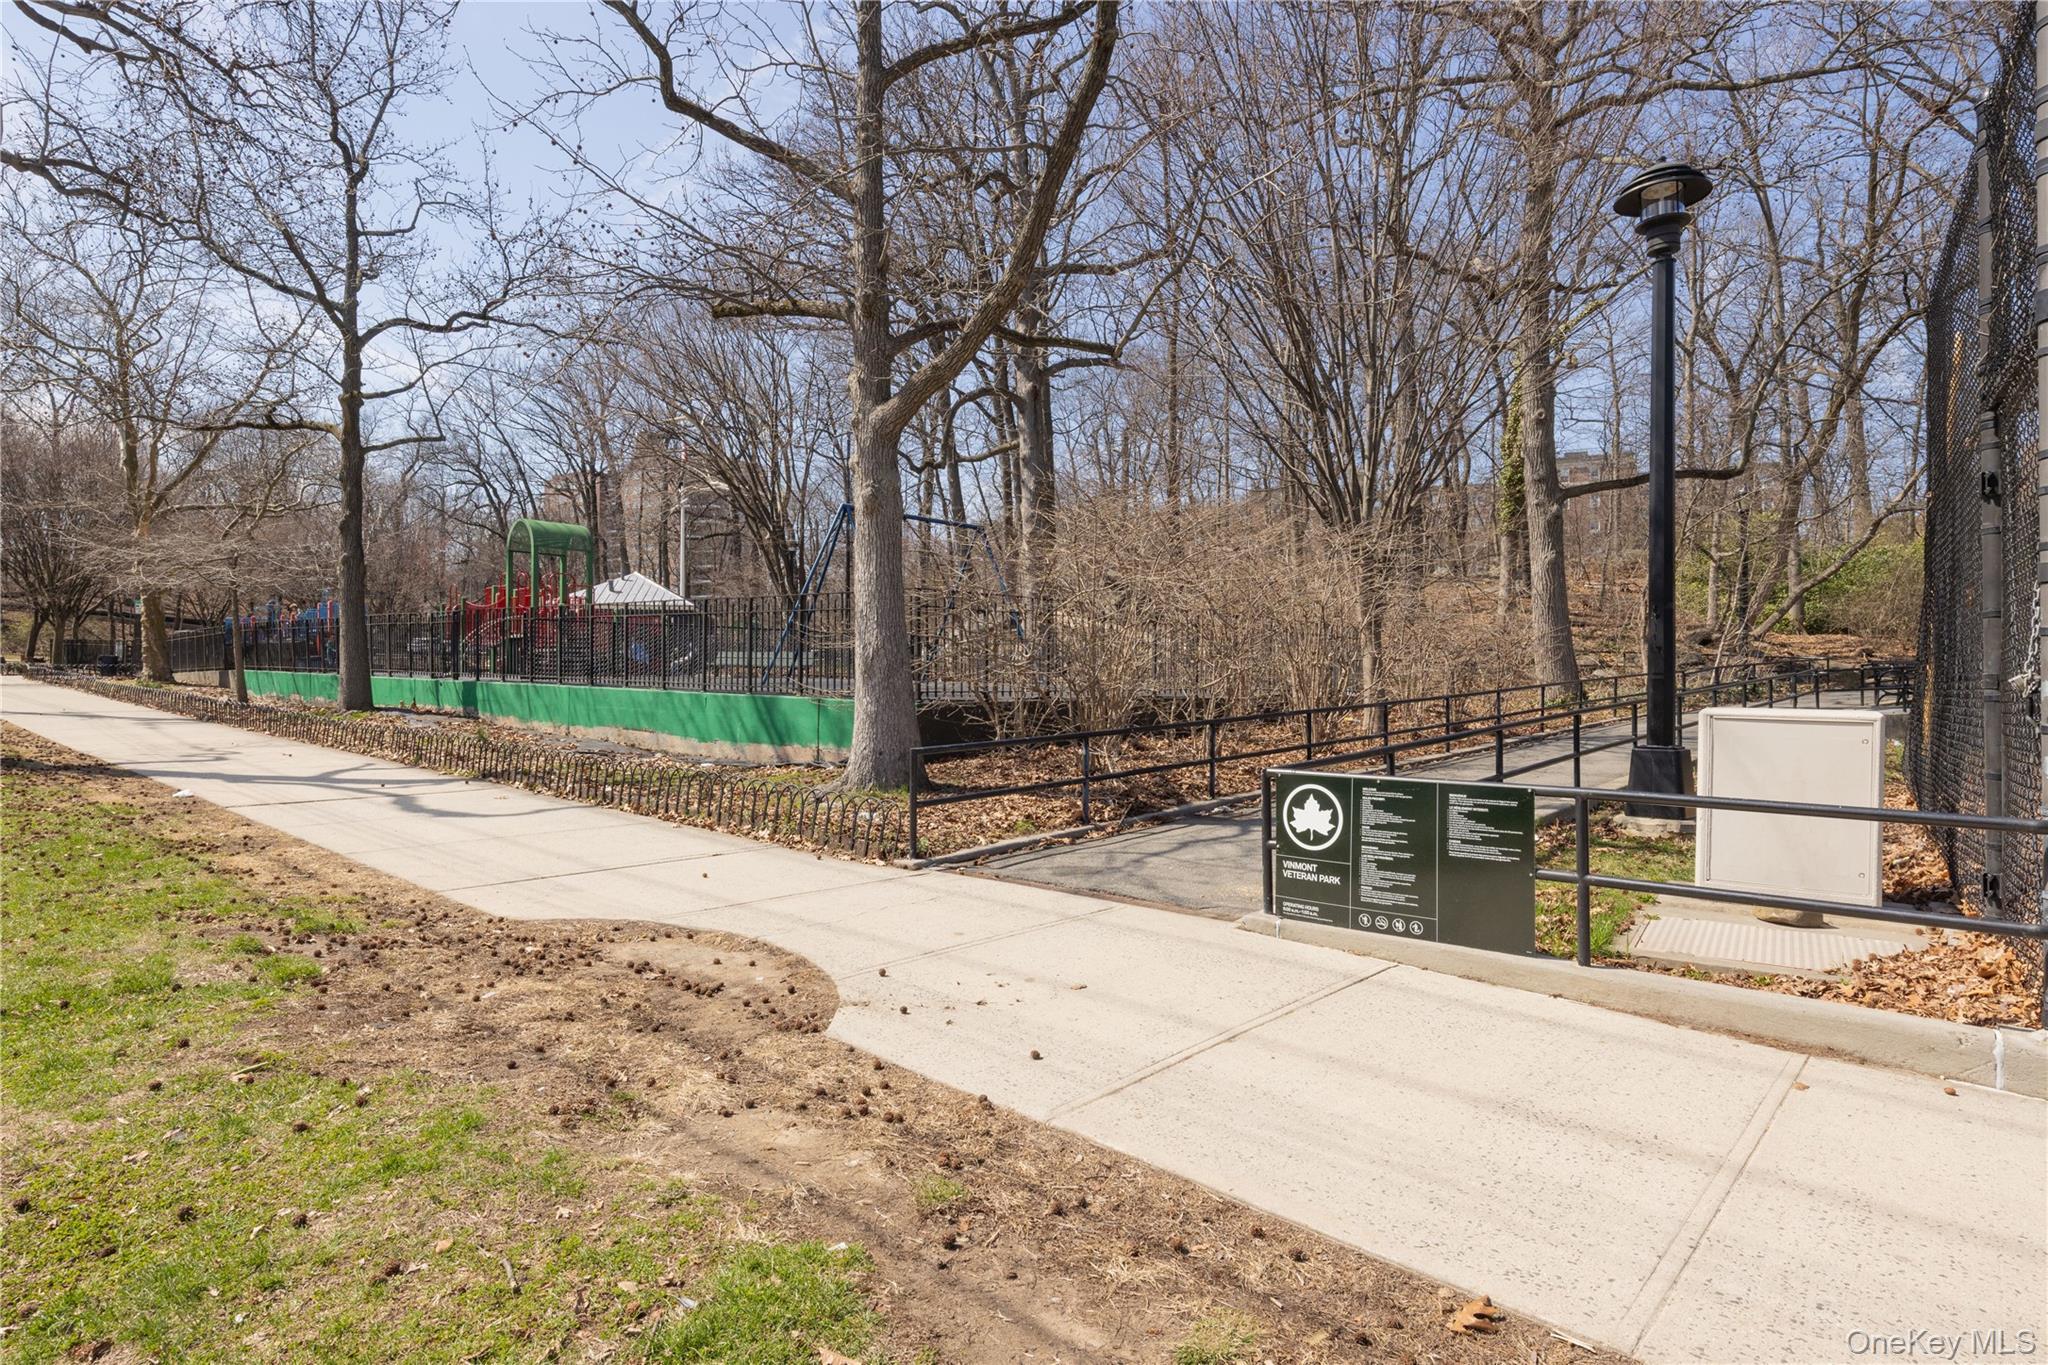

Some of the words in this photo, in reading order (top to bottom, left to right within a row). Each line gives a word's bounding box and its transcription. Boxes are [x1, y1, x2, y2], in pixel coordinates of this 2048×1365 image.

[1282, 860, 1319, 872] VINMONT
[1282, 869, 1318, 882] VETERAN
[1319, 874, 1341, 885] PARK
